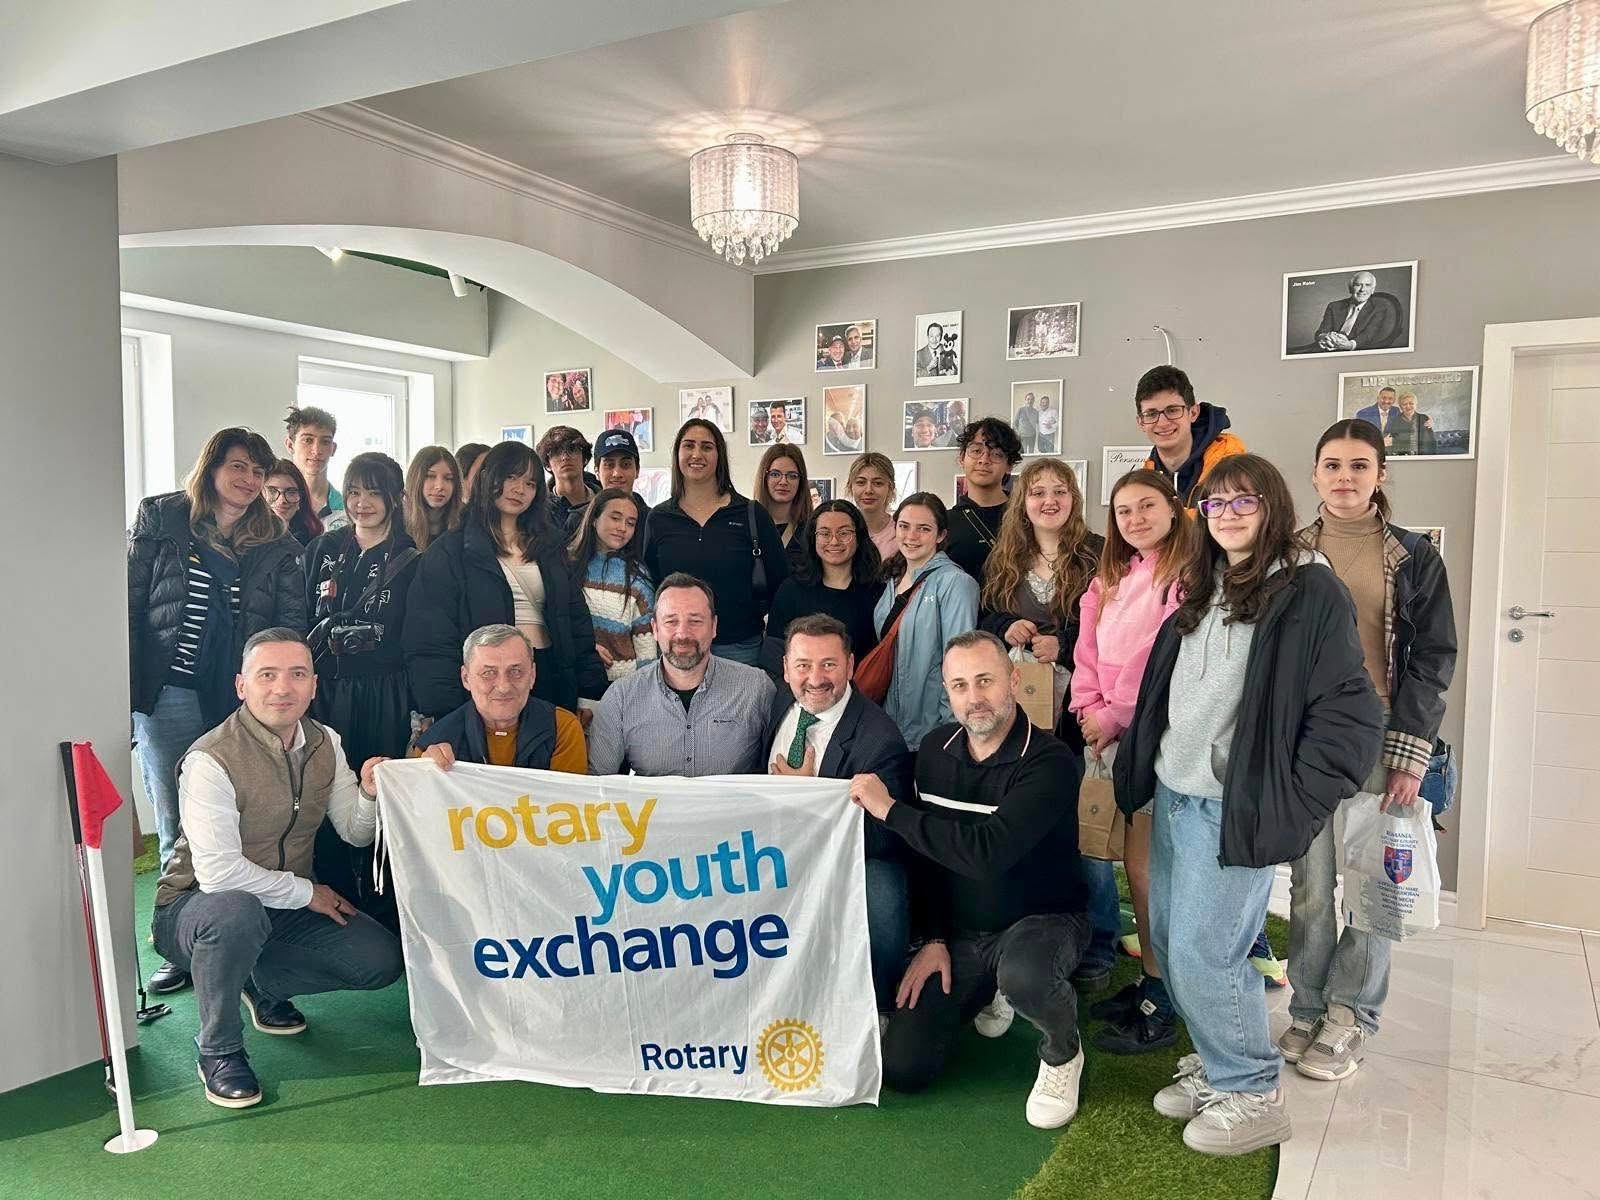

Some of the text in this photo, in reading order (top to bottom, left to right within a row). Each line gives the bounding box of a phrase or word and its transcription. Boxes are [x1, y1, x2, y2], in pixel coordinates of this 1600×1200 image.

[448, 794, 657, 855] rotary
[582, 830, 788, 925] youth
[473, 913, 790, 979] exchange
[640, 1042, 748, 1075] Rotary
